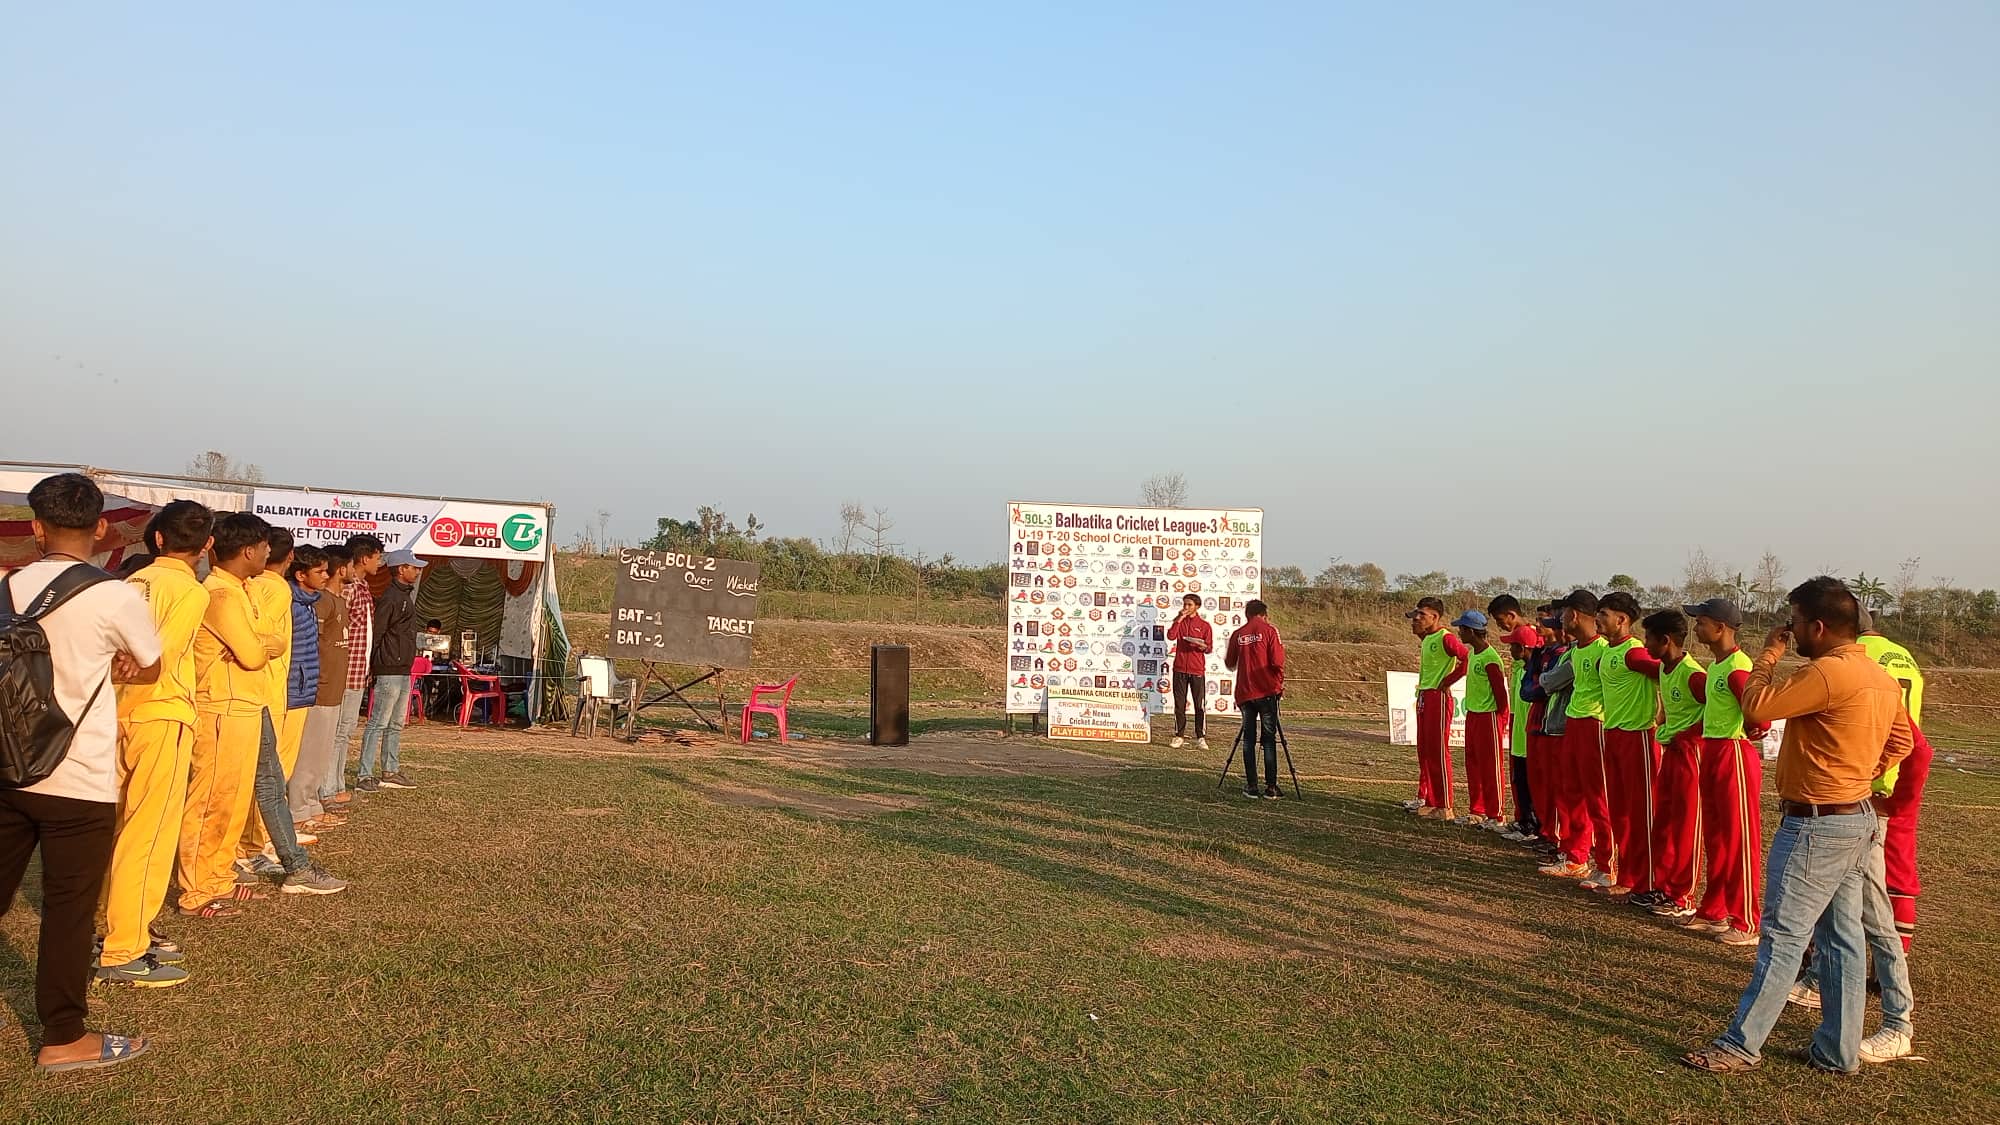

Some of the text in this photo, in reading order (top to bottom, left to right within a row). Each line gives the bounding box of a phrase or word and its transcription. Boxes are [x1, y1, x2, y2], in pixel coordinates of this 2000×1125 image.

[256, 504, 428, 524] BALBATIKA CRICKET LEAGUE-3
[346, 522, 376, 530] SCHOOL
[465, 523, 496, 536] Live
[1055, 512, 1112, 530] Balbatika
[1116, 514, 1159, 531] Cricket
[1163, 516, 1218, 536] League-3
[315, 528, 401, 544] TOURENT
[474, 537, 496, 548] on
[1018, 529, 1044, 541] U-19
[1046, 530, 1070, 542] T-20
[1073, 531, 1111, 543] School
[1113, 533, 1153, 545] Cricket
[1154, 534, 1250, 549] Tournament-2078
[665, 551, 718, 571] BCL-2
[629, 563, 660, 579] Run
[684, 571, 714, 586] Over
[726, 575, 759, 592] Wicket
[707, 616, 755, 634] TARGET
[1061, 688, 1094, 697] BALBATIKA
[1094, 690, 1120, 698] CRICKET
[1121, 691, 1149, 700] LEAGUE-3
[1092, 709, 1111, 718] Nexus
[1069, 717, 1119, 729] Cricket Academy
[1052, 728, 1146, 740] PLAYER OF THE MATCH
